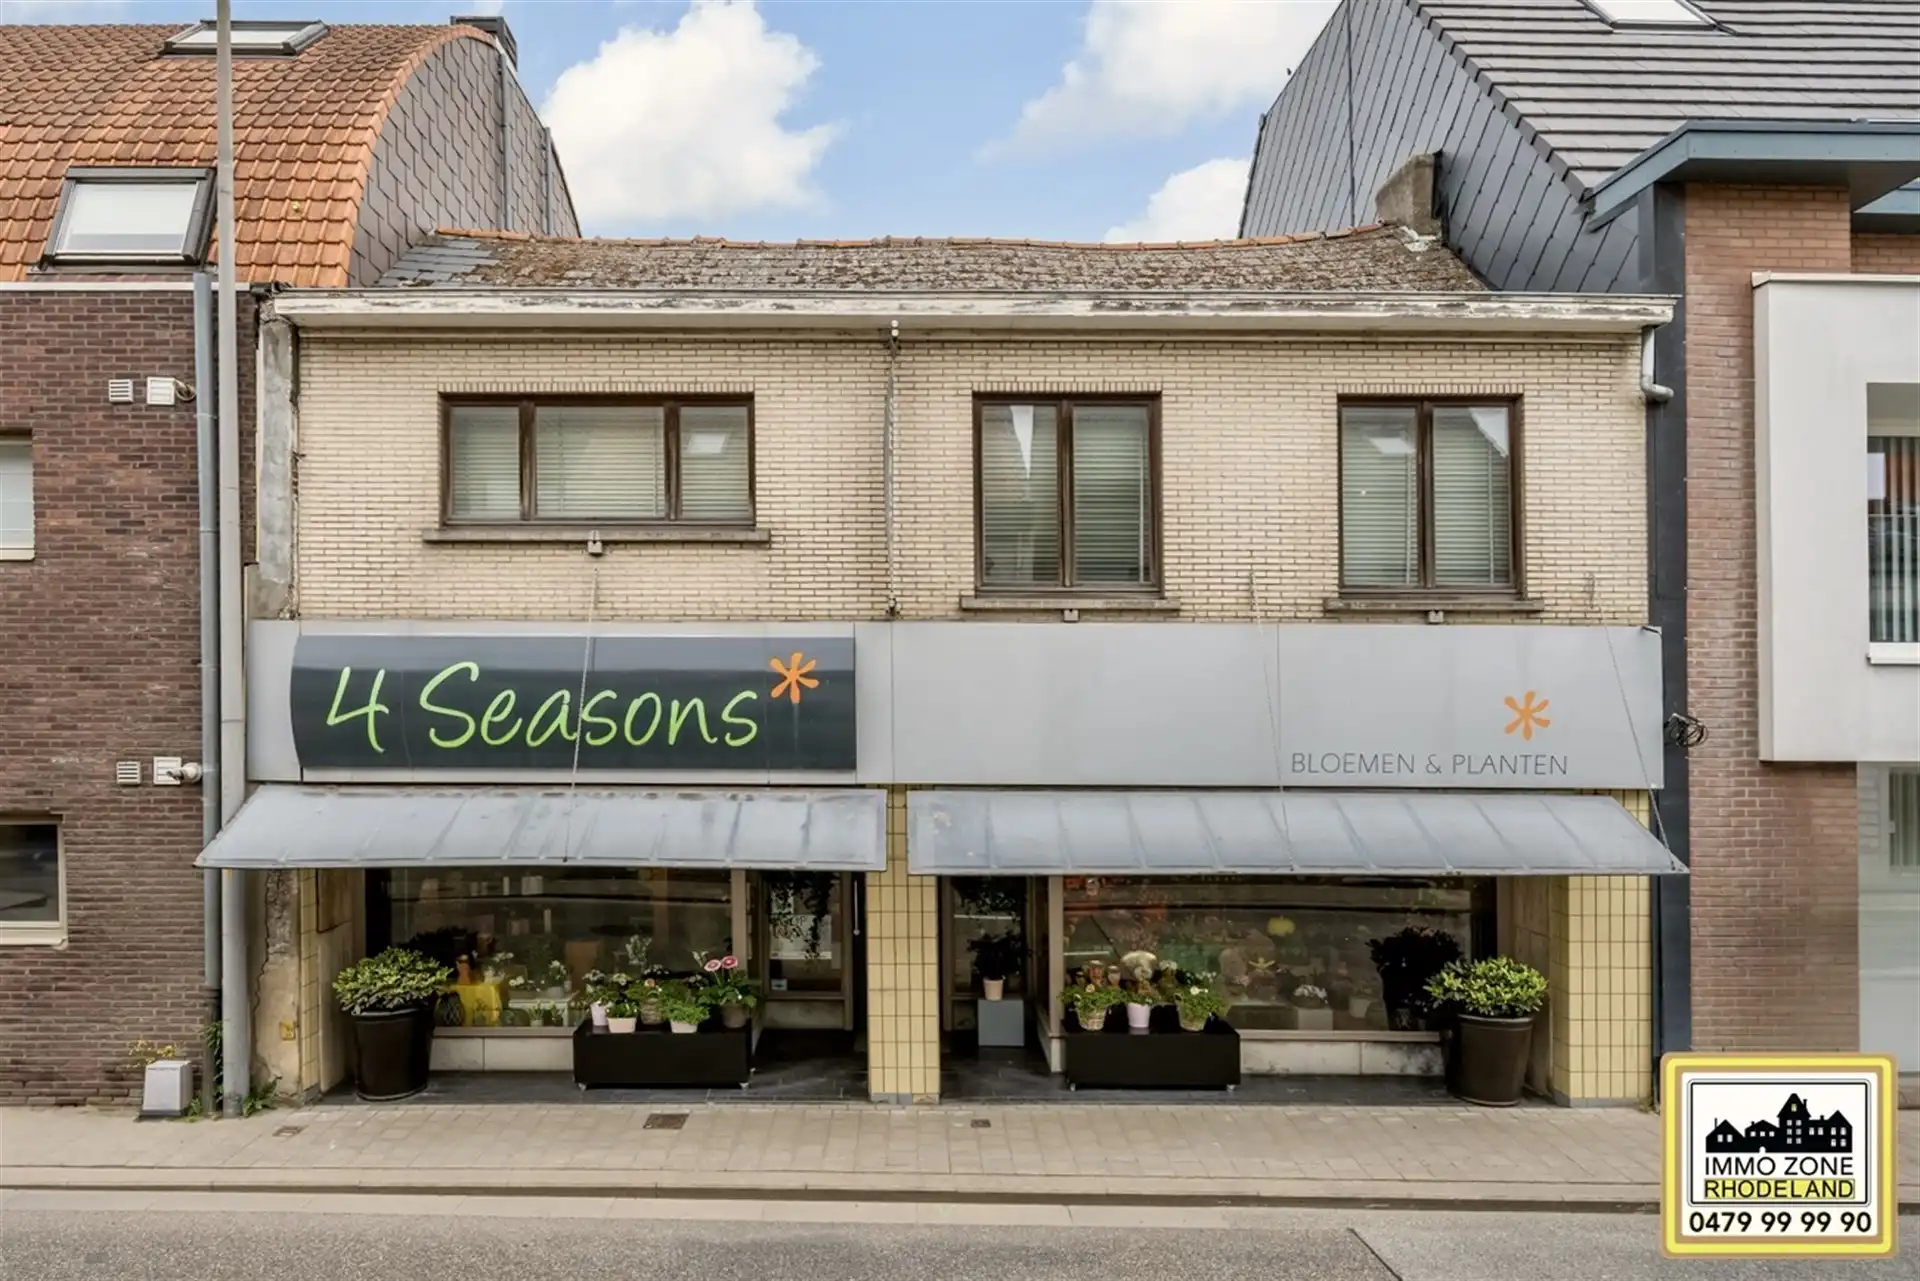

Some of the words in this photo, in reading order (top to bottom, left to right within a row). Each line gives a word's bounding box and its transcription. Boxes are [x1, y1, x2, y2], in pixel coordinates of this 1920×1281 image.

[326, 665, 390, 753] 4
[418, 660, 758, 748] Seasons
[1291, 752, 1415, 774] BLOEMEN
[1425, 753, 1443, 774] &
[1452, 754, 1568, 776] PLANTEN
